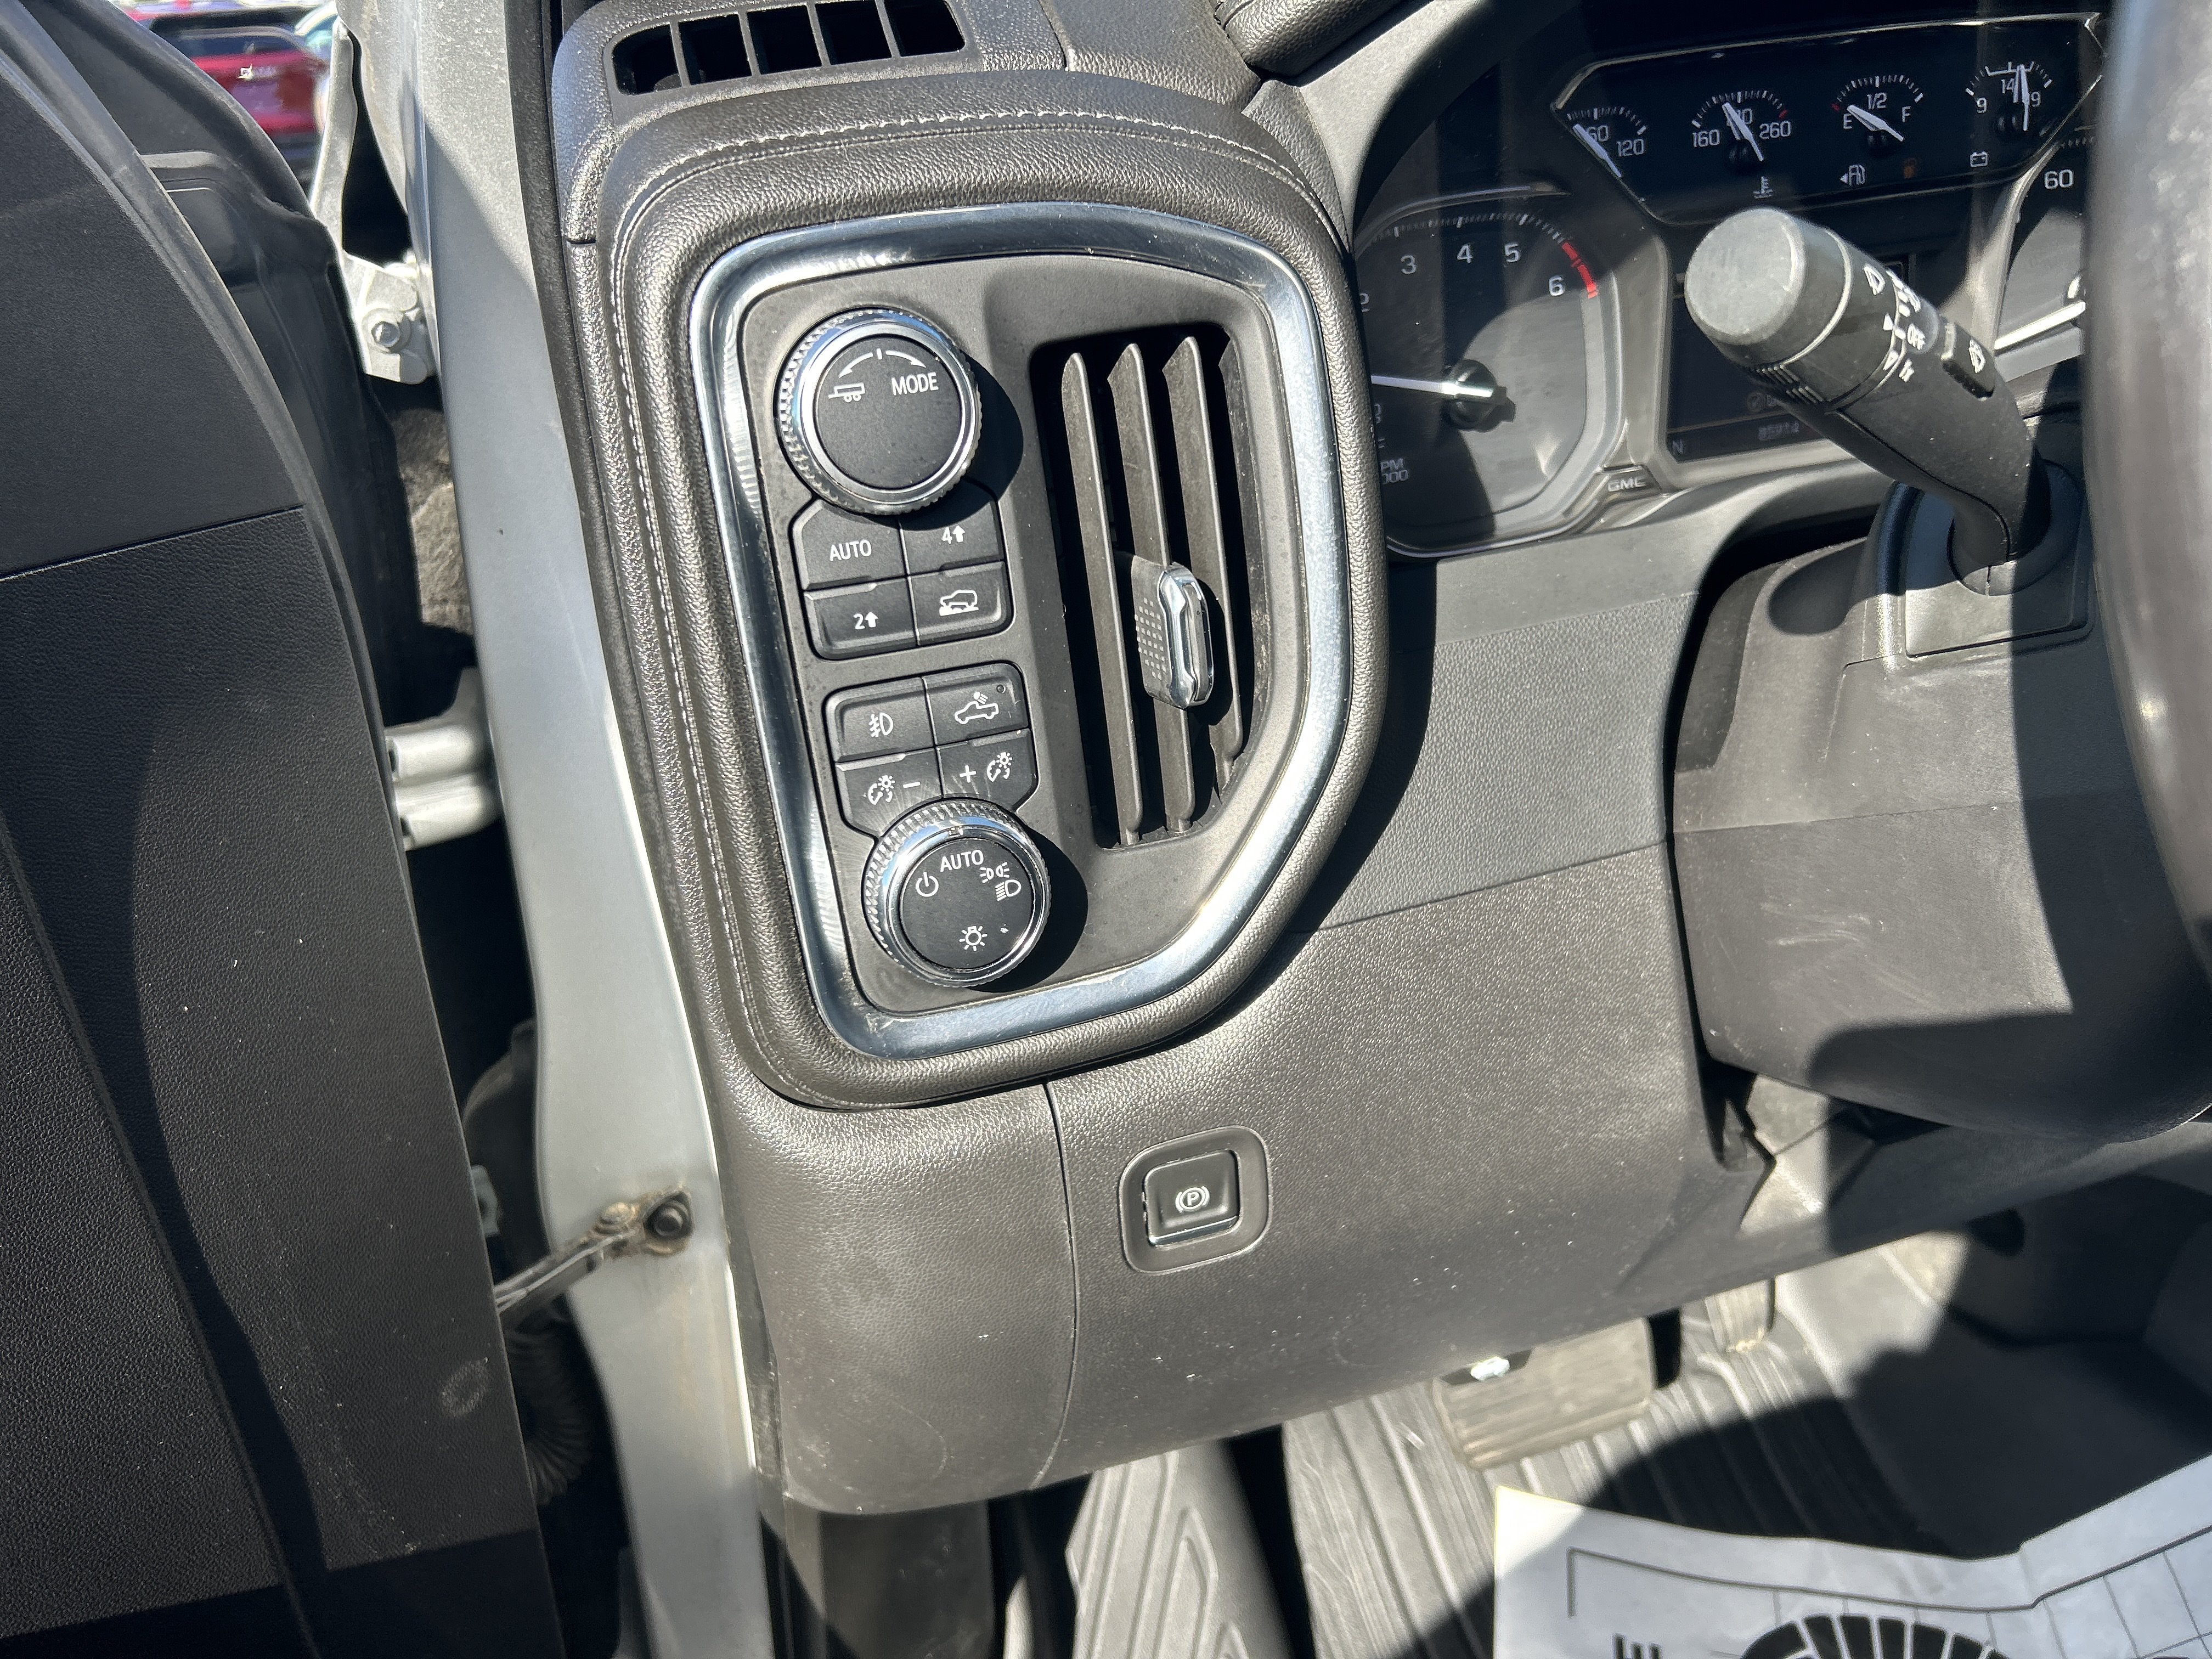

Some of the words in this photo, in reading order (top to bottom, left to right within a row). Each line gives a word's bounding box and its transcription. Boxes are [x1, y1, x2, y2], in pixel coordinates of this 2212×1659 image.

[1976, 98, 1988, 114] 9
[2028, 91, 2041, 107] 9
[1843, 113, 1853, 129] E
[1901, 106, 1912, 123] F
[1692, 129, 1721, 148] 160
[1759, 120, 1792, 140] 260
[1616, 138, 1645, 156] 120
[2044, 169, 2074, 189] 60
[1456, 244, 1474, 264] 4
[1504, 243, 1521, 263] 5
[1400, 255, 1417, 274] 3
[1548, 275, 1566, 297] 6
[891, 372, 939, 396] MODE
[1380, 458, 1404, 473] PM
[941, 527, 953, 544] 4
[829, 539, 872, 562] AUTO
[854, 613, 866, 630] 2
[940, 849, 984, 872] AUTO
